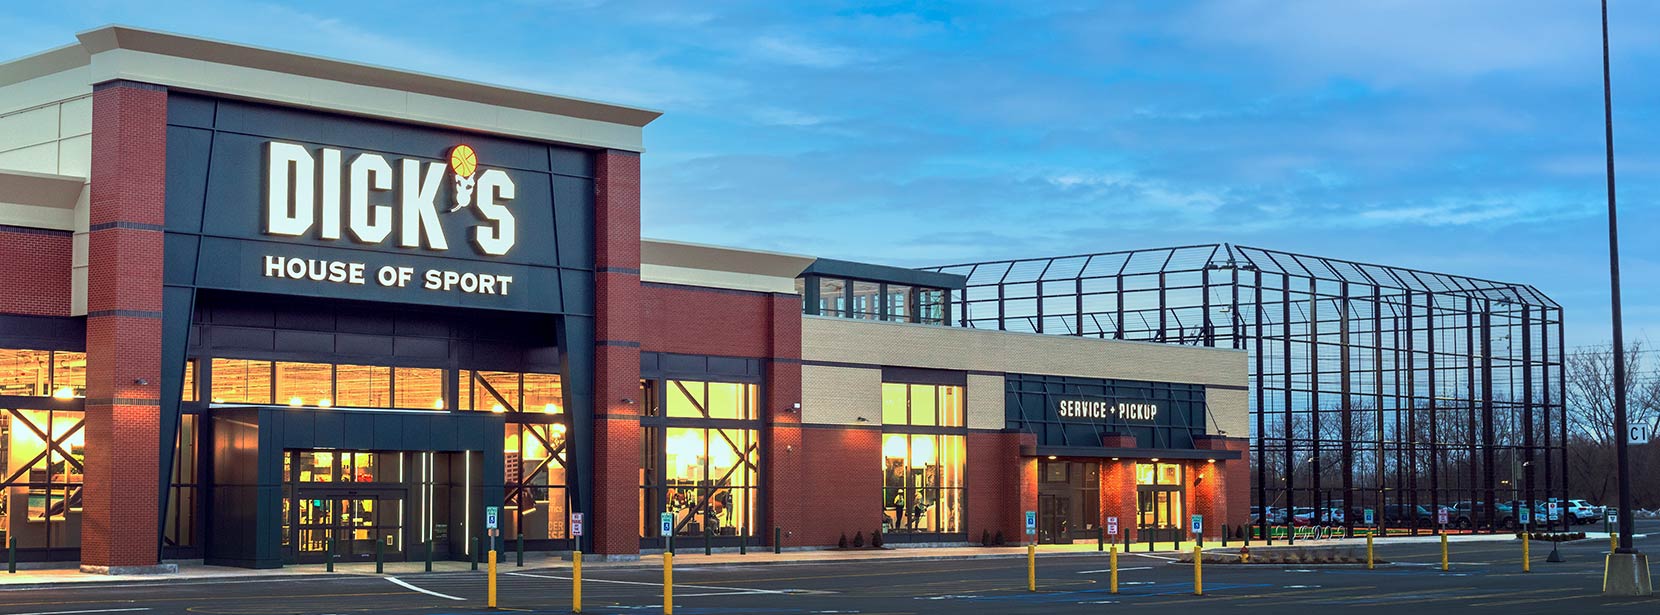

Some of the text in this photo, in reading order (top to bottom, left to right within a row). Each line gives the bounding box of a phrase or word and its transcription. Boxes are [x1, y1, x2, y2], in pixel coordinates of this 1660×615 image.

[265, 141, 515, 255] DICK'S
[264, 255, 514, 296] HOUSE OF SPORT
[1060, 400, 1107, 418] SERVICE
[1119, 403, 1158, 420] PICKUP
